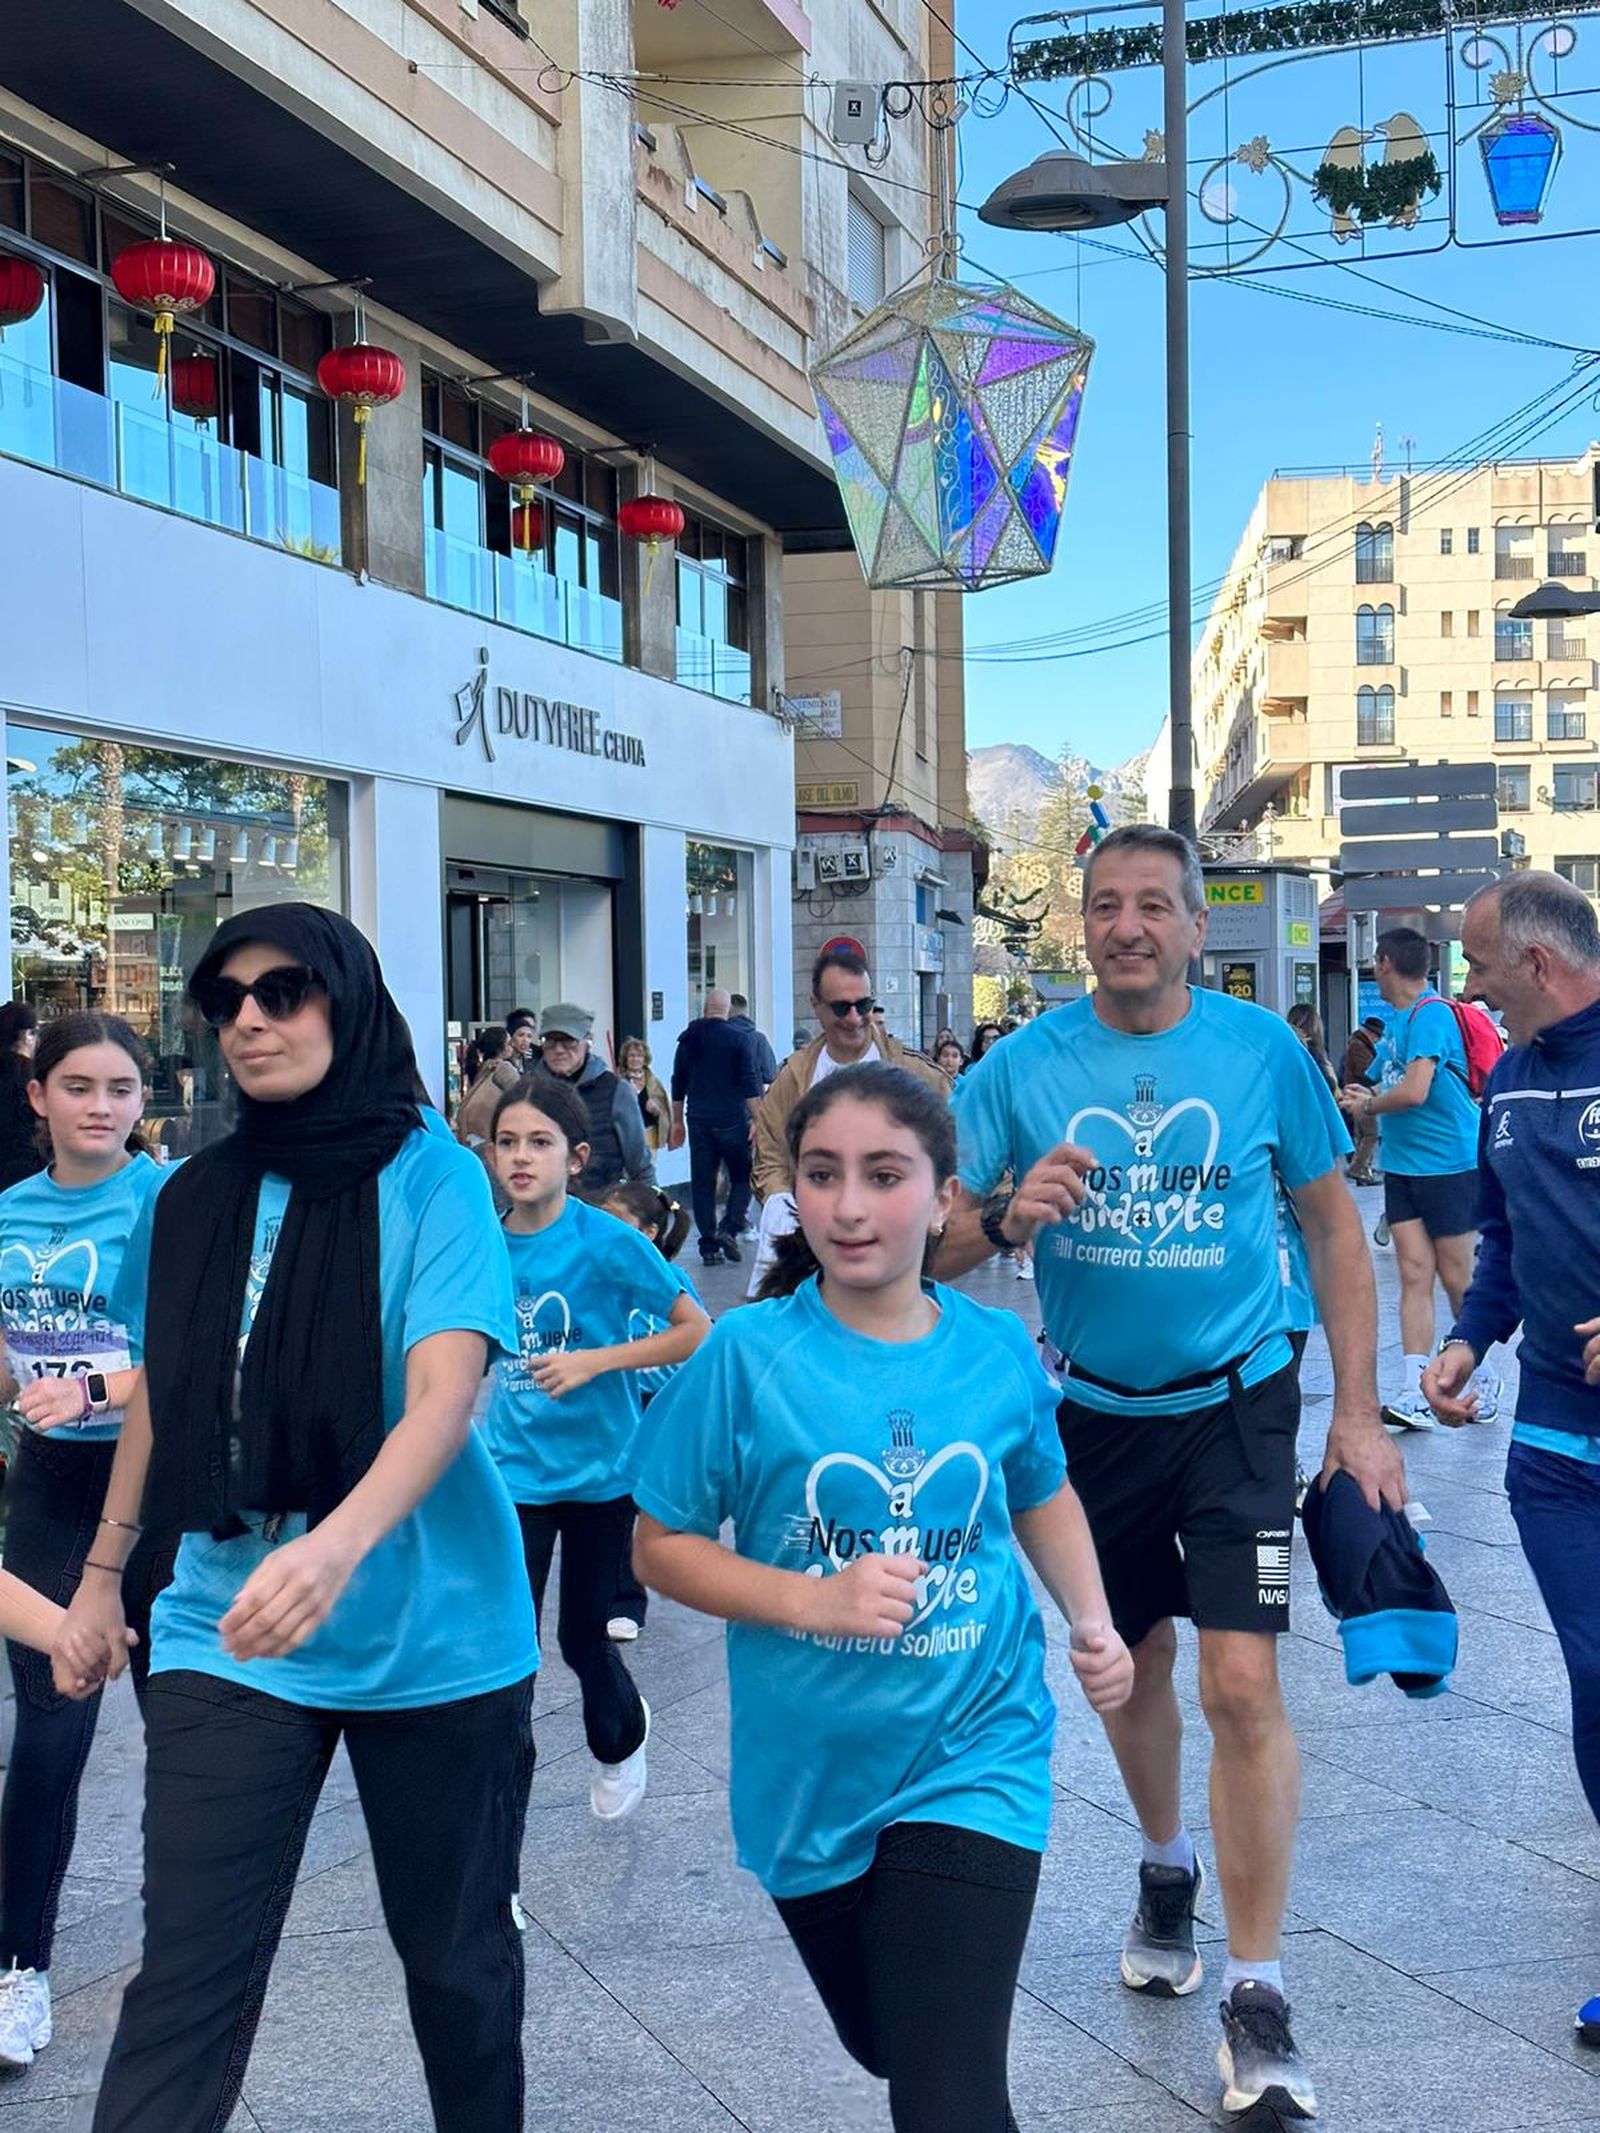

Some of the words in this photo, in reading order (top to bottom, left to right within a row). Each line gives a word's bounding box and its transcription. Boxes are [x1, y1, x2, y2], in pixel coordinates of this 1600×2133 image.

[498, 686, 602, 756] DUTYFREE
[603, 730, 646, 767] CEUTA
[797, 787, 815, 802] OSE
[817, 787, 830, 801] DEL
[1204, 884, 1257, 902] NCE
[1082, 1165, 1122, 1192] os
[1076, 1244, 1142, 1267] carrera
[1146, 1242, 1226, 1268] solidaria
[0, 1286, 28, 1310] os
[807, 1516, 875, 1560] Nos
